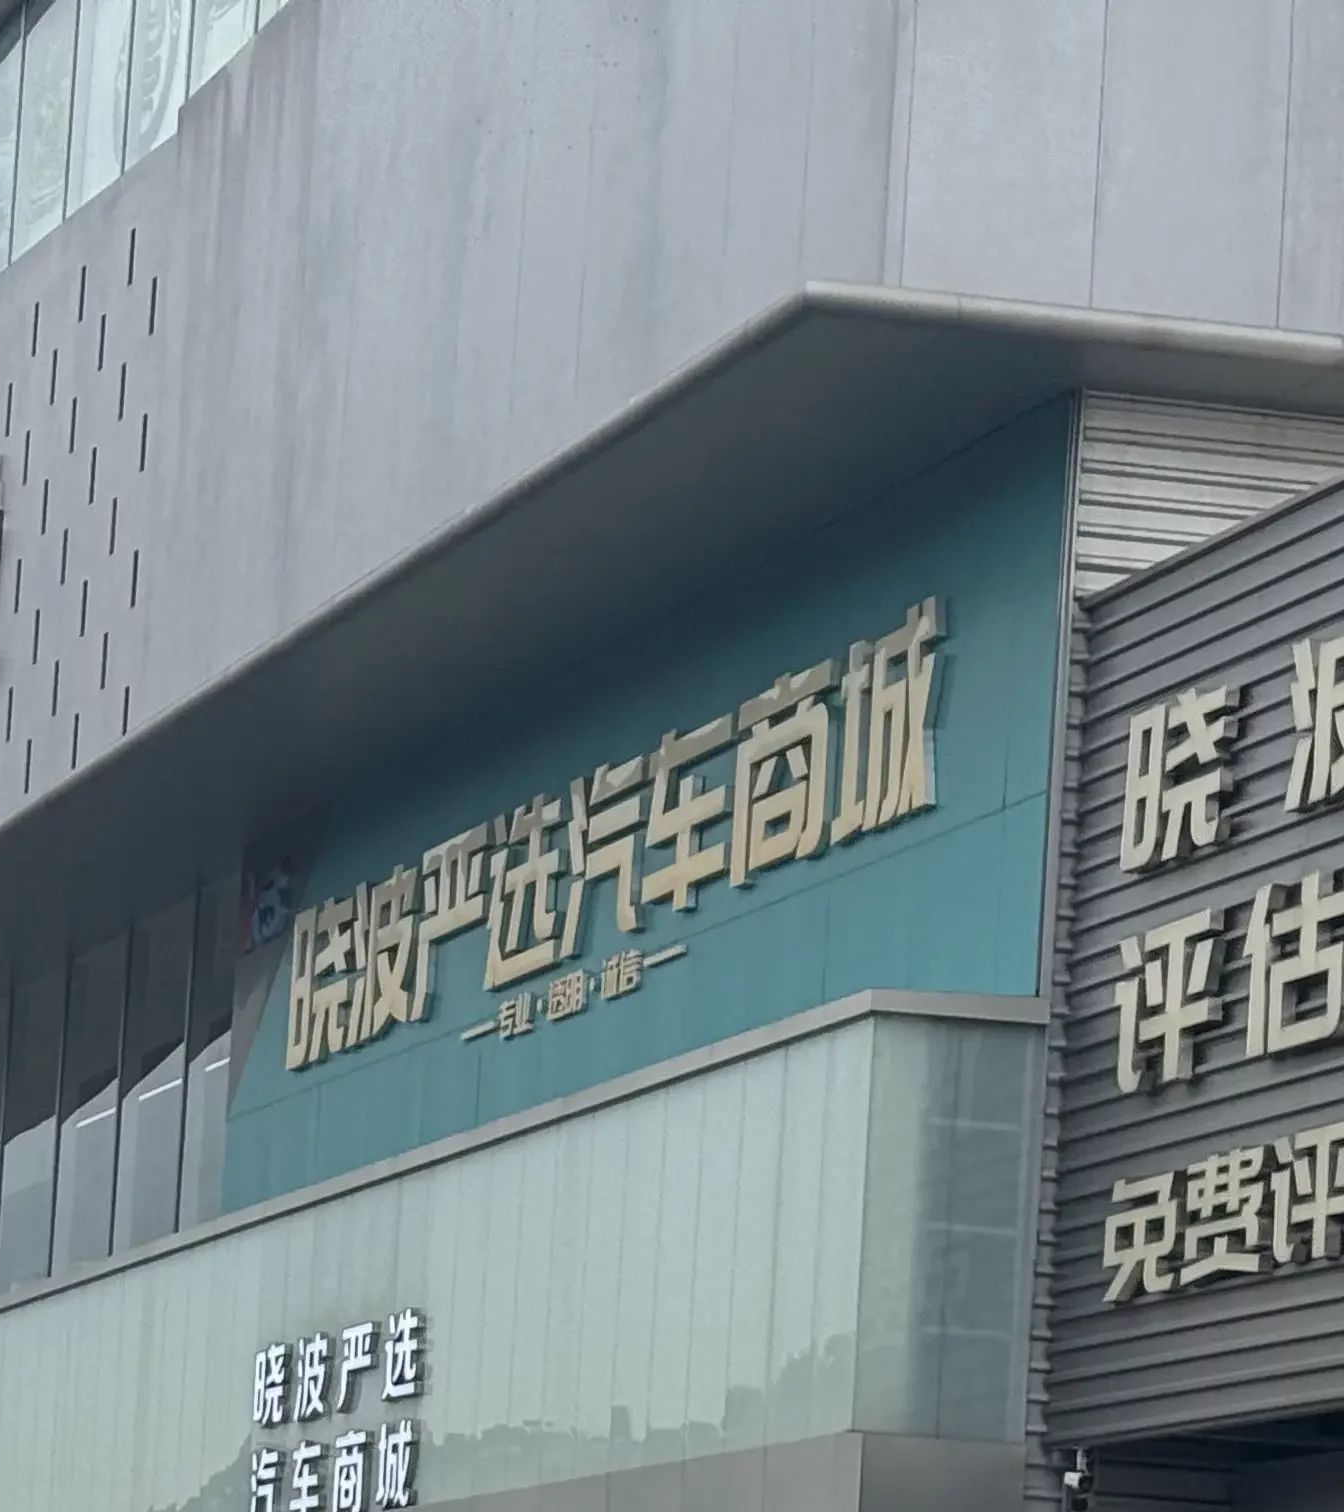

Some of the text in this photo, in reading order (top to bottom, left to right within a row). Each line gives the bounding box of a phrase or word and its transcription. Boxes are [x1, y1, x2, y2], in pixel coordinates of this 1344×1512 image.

[286, 595, 948, 1071] 晓波严选汽车商城
[1115, 870, 1344, 1095] 评估
[252, 1307, 423, 1426] 晓波严选
